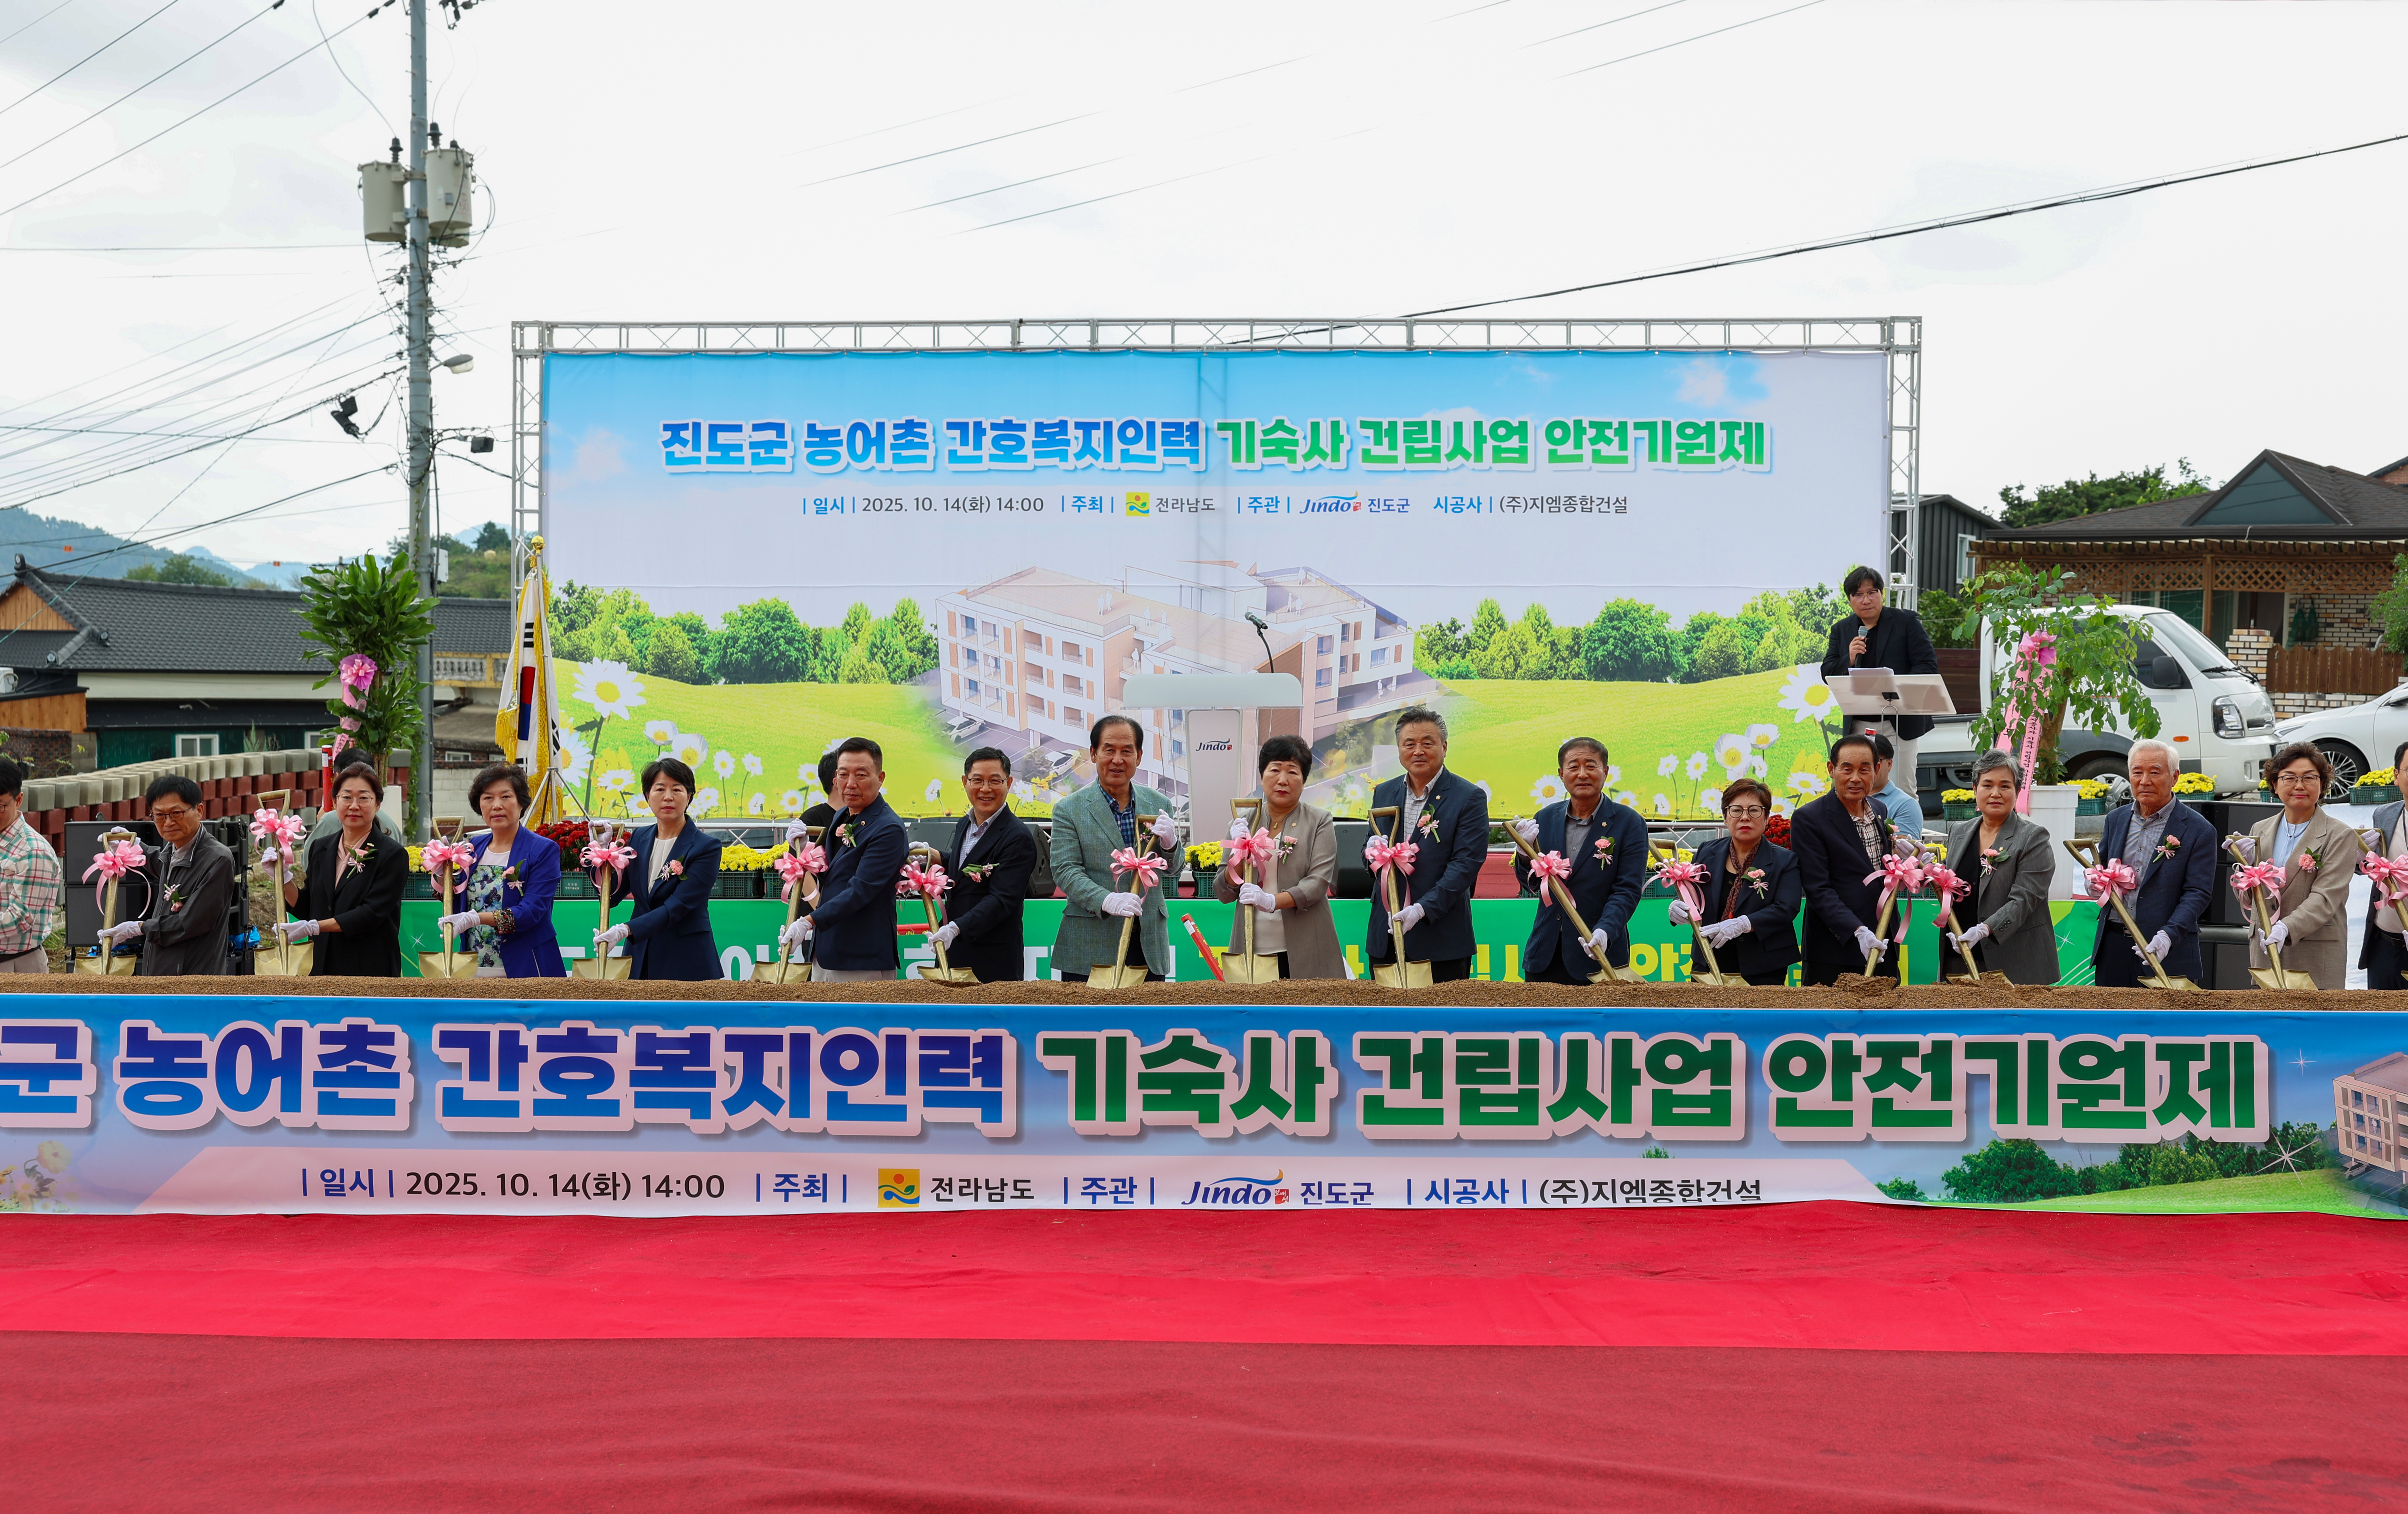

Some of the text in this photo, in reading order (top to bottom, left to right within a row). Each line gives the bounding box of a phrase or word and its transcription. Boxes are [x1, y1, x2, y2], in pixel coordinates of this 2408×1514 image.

[661, 419, 1764, 469] 진도군 농어촌 간호복지인력 기숙사 건립사업 안전기원제
[813, 497, 844, 515] 일시
[862, 498, 907, 512] 2025.
[913, 497, 938, 512] 10.
[943, 495, 991, 514] 14(화)
[996, 497, 1044, 512] 14:00
[1071, 496, 1103, 513] 주최
[1155, 497, 1215, 513] 전라남도
[1247, 496, 1280, 514] 주관
[1300, 500, 1352, 514] Jindo
[1368, 497, 1410, 513] 진도군
[1433, 496, 1483, 514] 시공사
[1499, 495, 1628, 515] (주)지엠종합건설
[1195, 742, 1226, 751] Jindo
[0, 1024, 2255, 1129] 군 농어촌 간호복지인력 기숙사 건립사업 안전기원제
[319, 1168, 1763, 1206] 일시 2025. 10. 14(화) 14:00 주최 전라남도 주관 Jindo 진도군 시공사 (주)지엠종합건설
